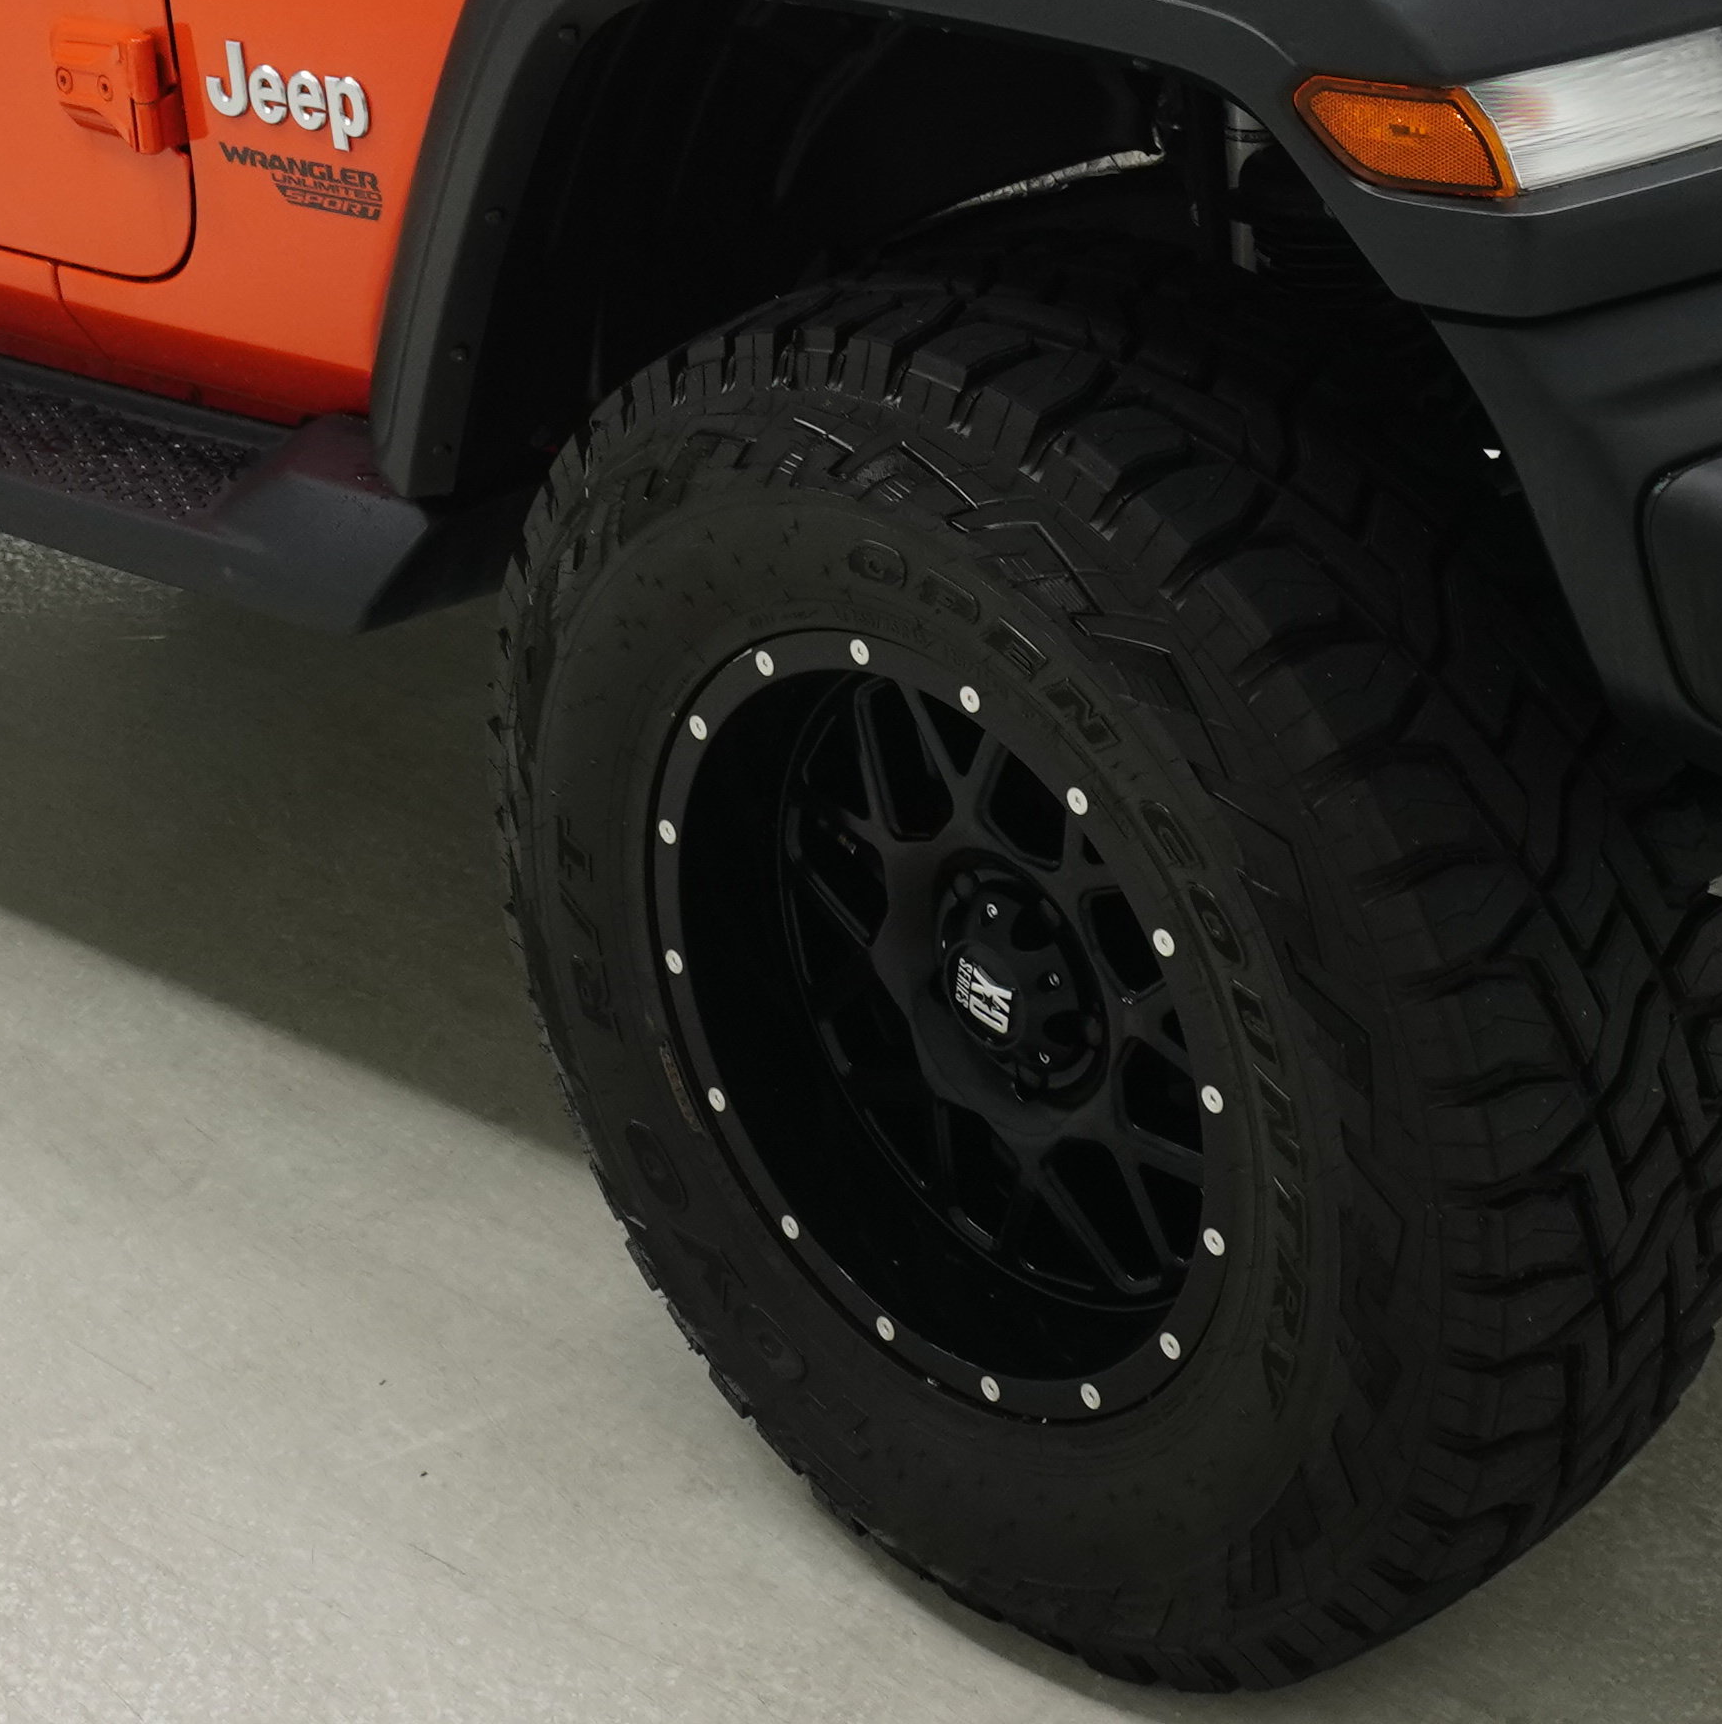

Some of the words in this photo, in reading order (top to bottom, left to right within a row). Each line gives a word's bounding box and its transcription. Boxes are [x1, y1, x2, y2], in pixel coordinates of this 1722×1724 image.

[206, 40, 369, 151] Jeep
[220, 142, 380, 191] WRANGLER
[271, 173, 383, 202] UNLIMITED
[282, 188, 382, 219] SPORT
